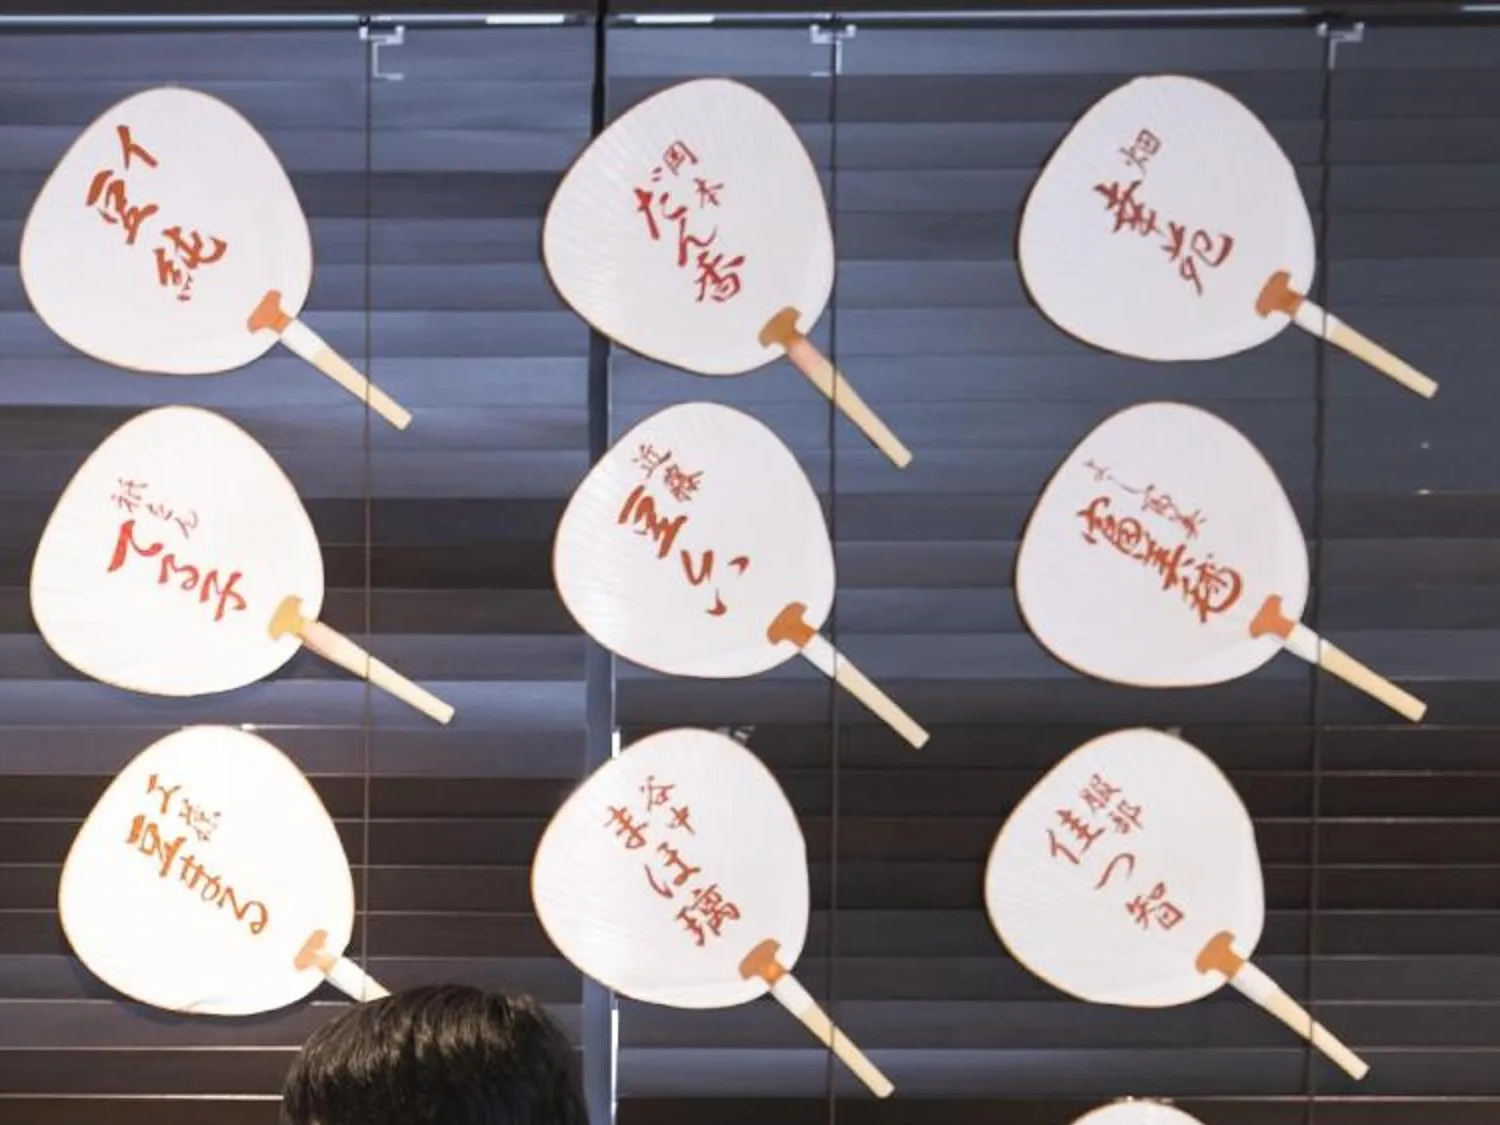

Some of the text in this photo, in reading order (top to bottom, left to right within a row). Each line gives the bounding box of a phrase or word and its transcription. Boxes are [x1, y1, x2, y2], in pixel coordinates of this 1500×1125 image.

[662, 140, 725, 209] 岡本
[1118, 127, 1162, 175] 畑
[632, 166, 746, 304] だん香
[633, 444, 704, 502] 近藤
[640, 775, 694, 834] 谷中
[1082, 773, 1142, 835] 服部
[1046, 809, 1185, 930] 佳つ智
